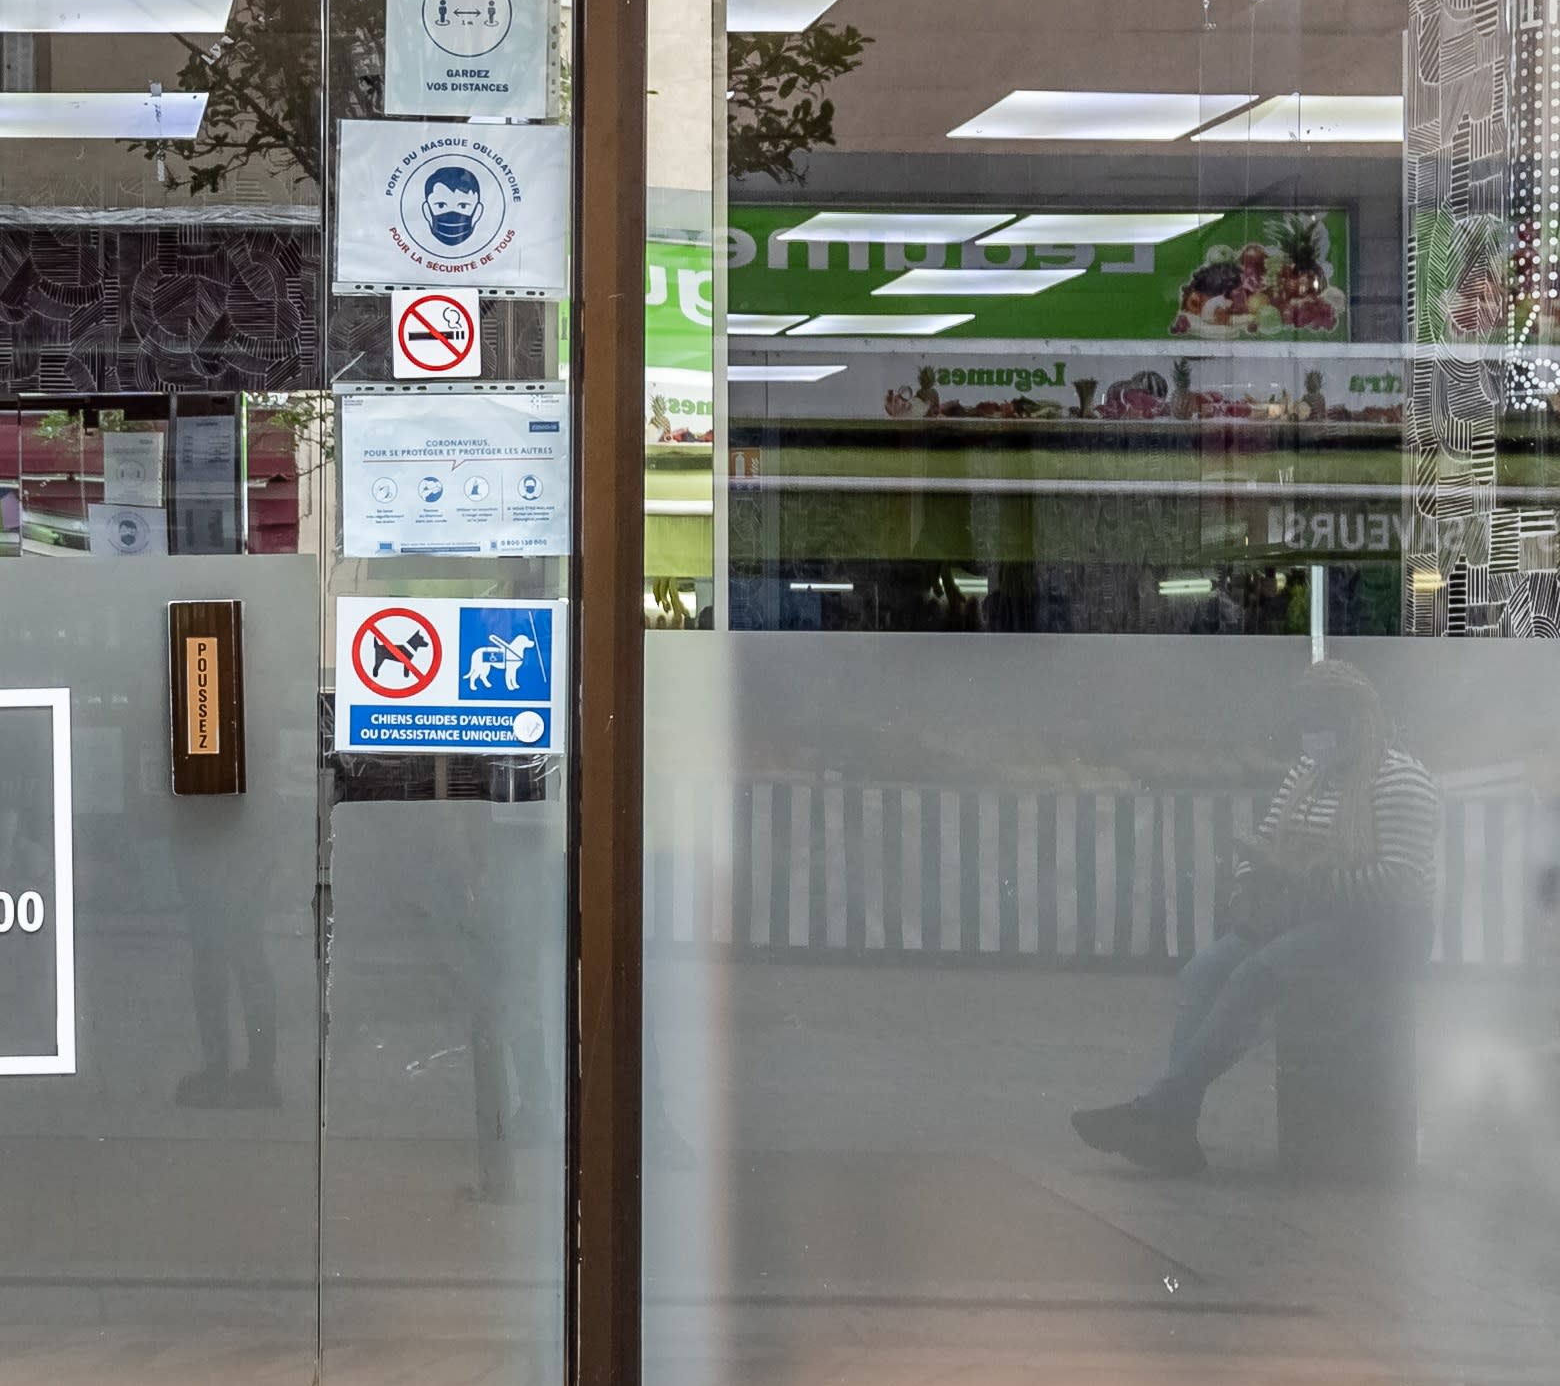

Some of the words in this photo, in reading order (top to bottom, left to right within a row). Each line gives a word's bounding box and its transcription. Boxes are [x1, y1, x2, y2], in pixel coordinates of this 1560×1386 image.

[446, 69, 491, 79] GARDEZ
[426, 82, 448, 92] VOS
[451, 82, 510, 93] DISTANCES
[385, 166, 404, 197] PORT
[402, 151, 418, 166] DU
[420, 137, 469, 154] MASQUE
[472, 142, 522, 203] OBLIGATOIRE
[388, 226, 411, 254] POUR
[410, 250, 423, 265] LA
[425, 260, 478, 274] SÉCURITÉ
[479, 252, 495, 266] DE
[494, 228, 517, 254] TOUS
[364, 449, 388, 458] POUR
[388, 449, 401, 457] SE
[401, 446, 444, 457] PROTÉGER
[446, 448, 457, 456] ET
[458, 445, 503, 456] PROTÉGER
[504, 447, 520, 455] LES
[520, 446, 554, 455] AUTRES
[197, 642, 208, 749] POUSSEZ
[370, 713, 413, 725] CHIENS
[414, 714, 458, 726] GUIDES
[459, 715, 514, 727] D'AVEUGL
[360, 728, 379, 740] OU
[380, 728, 460, 741] D'ASSISTANCE
[462, 730, 519, 742] UNIQUEM
